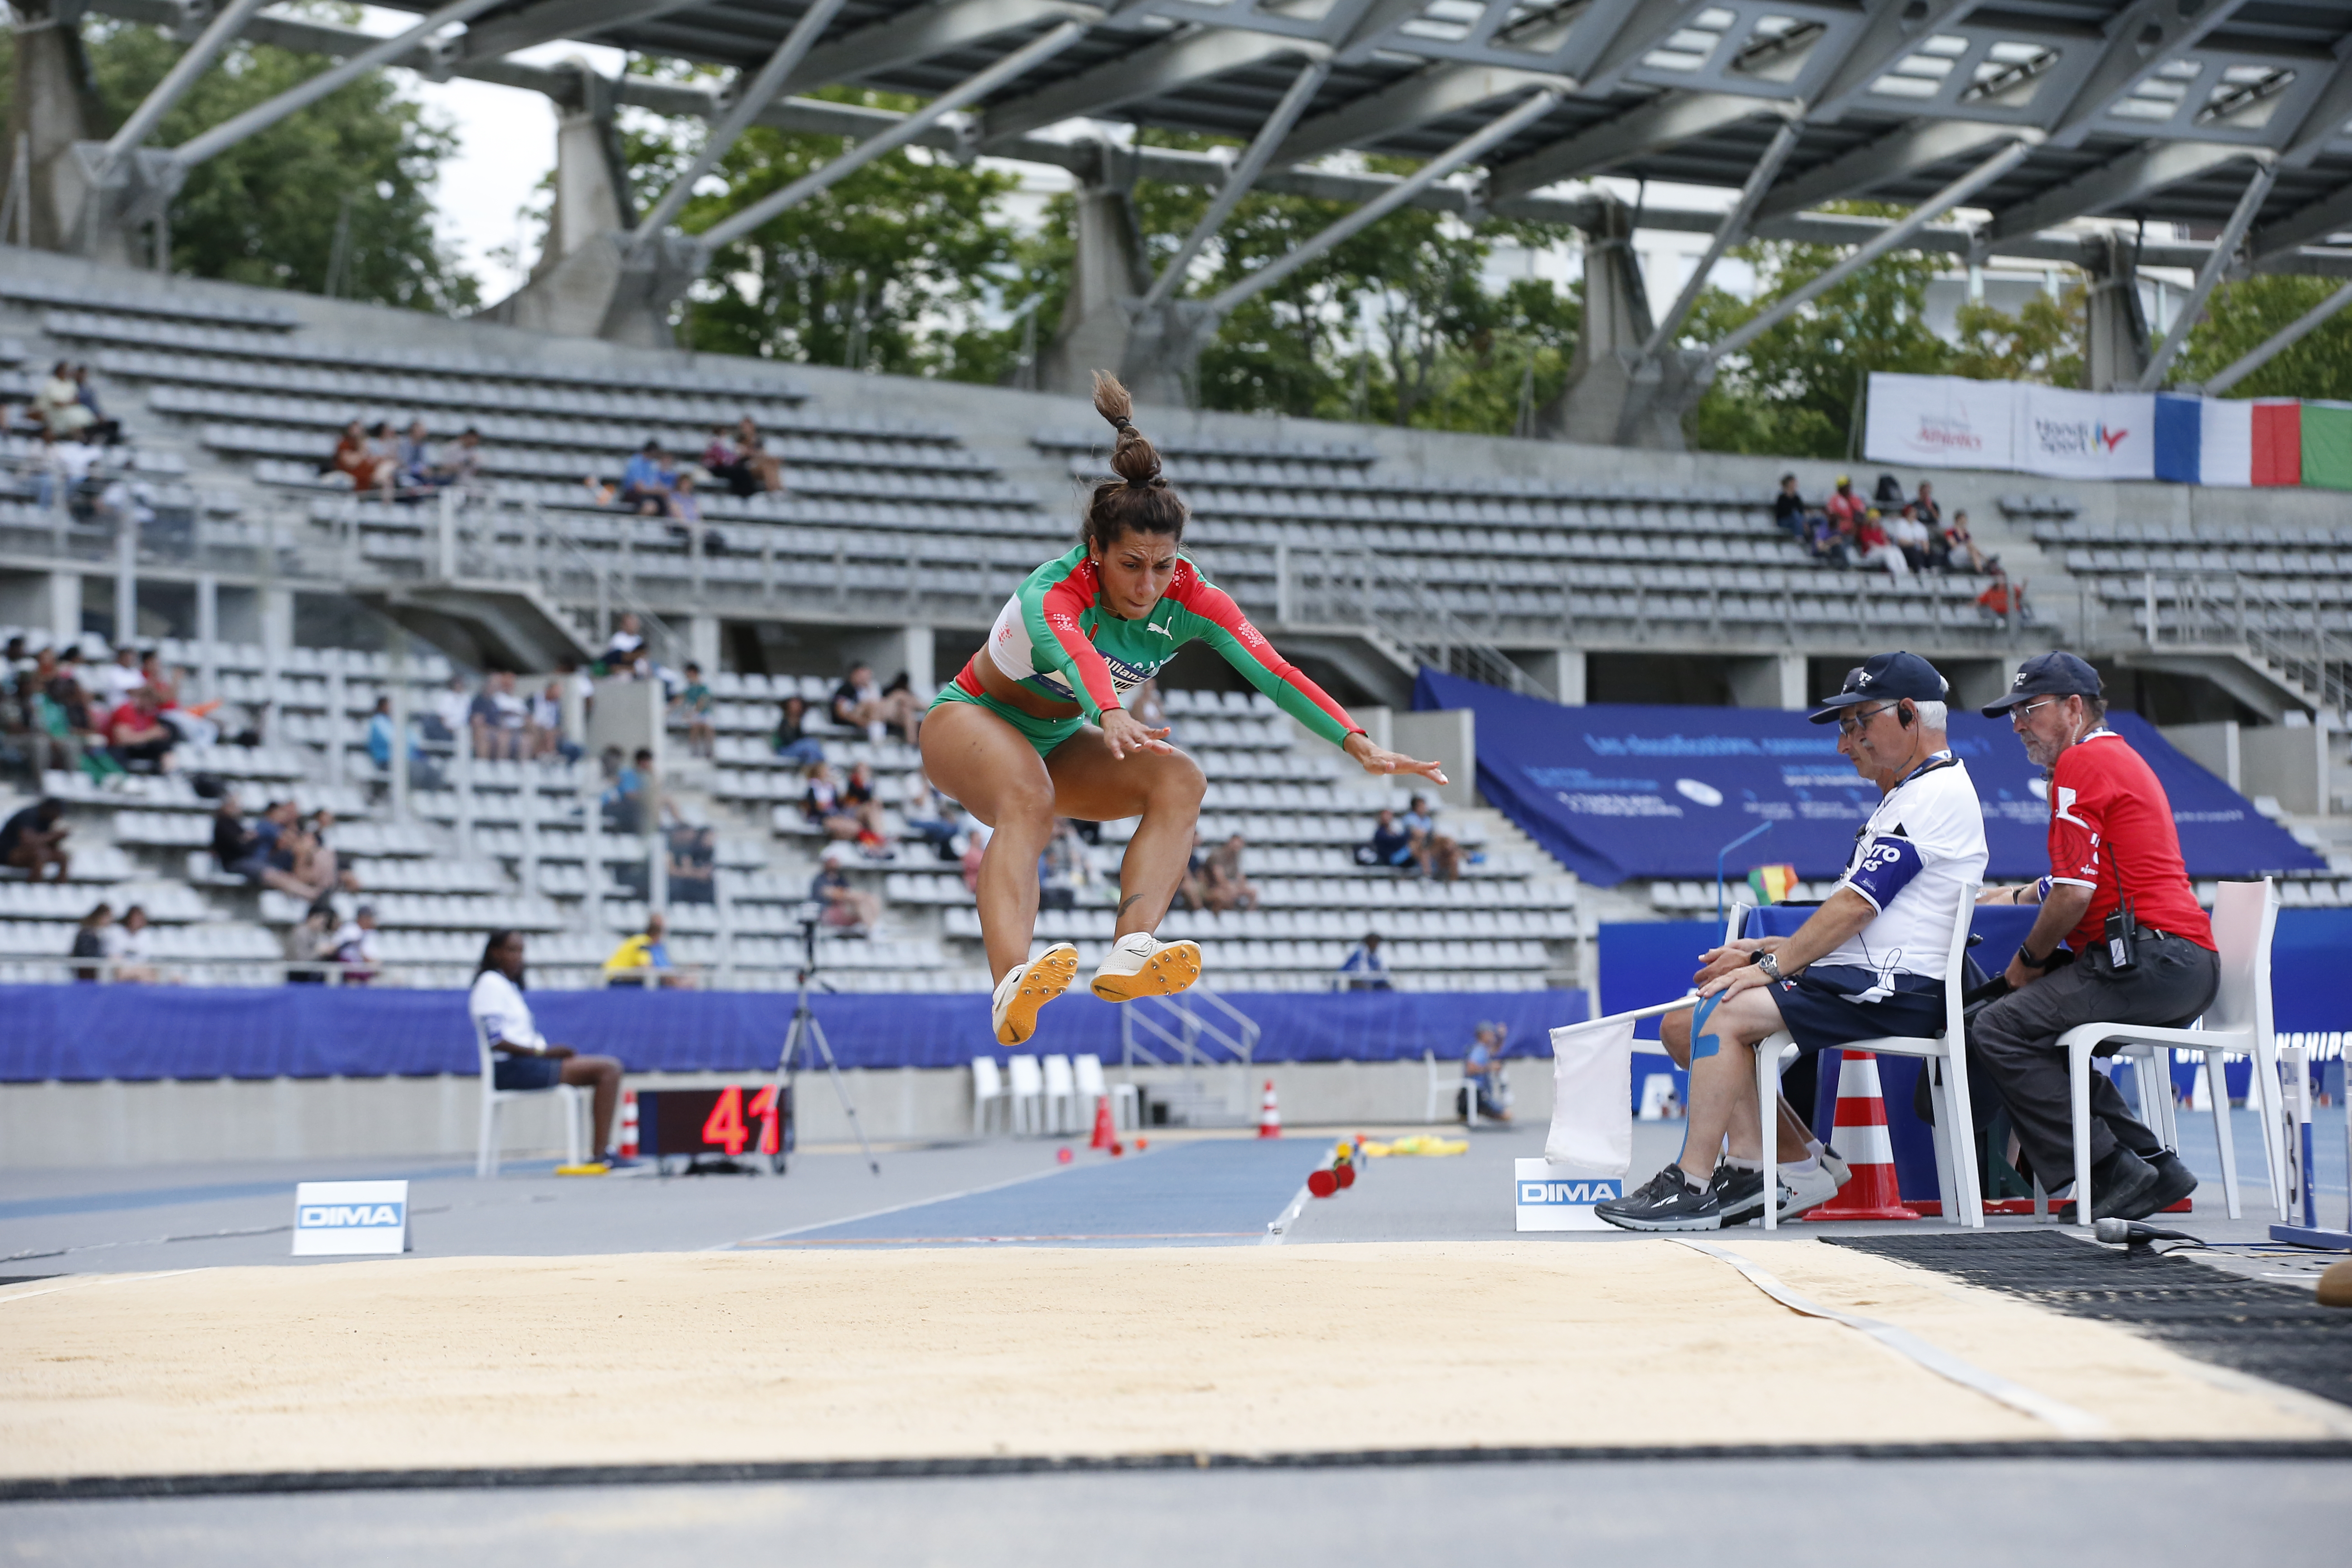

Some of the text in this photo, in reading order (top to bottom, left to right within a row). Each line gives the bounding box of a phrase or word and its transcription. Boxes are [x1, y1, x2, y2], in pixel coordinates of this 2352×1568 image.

[1103, 656, 1146, 681] Allianz
[702, 1084, 779, 1155] 41
[1522, 1183, 1617, 1202] DIMA
[301, 1205, 399, 1227] DIMA
